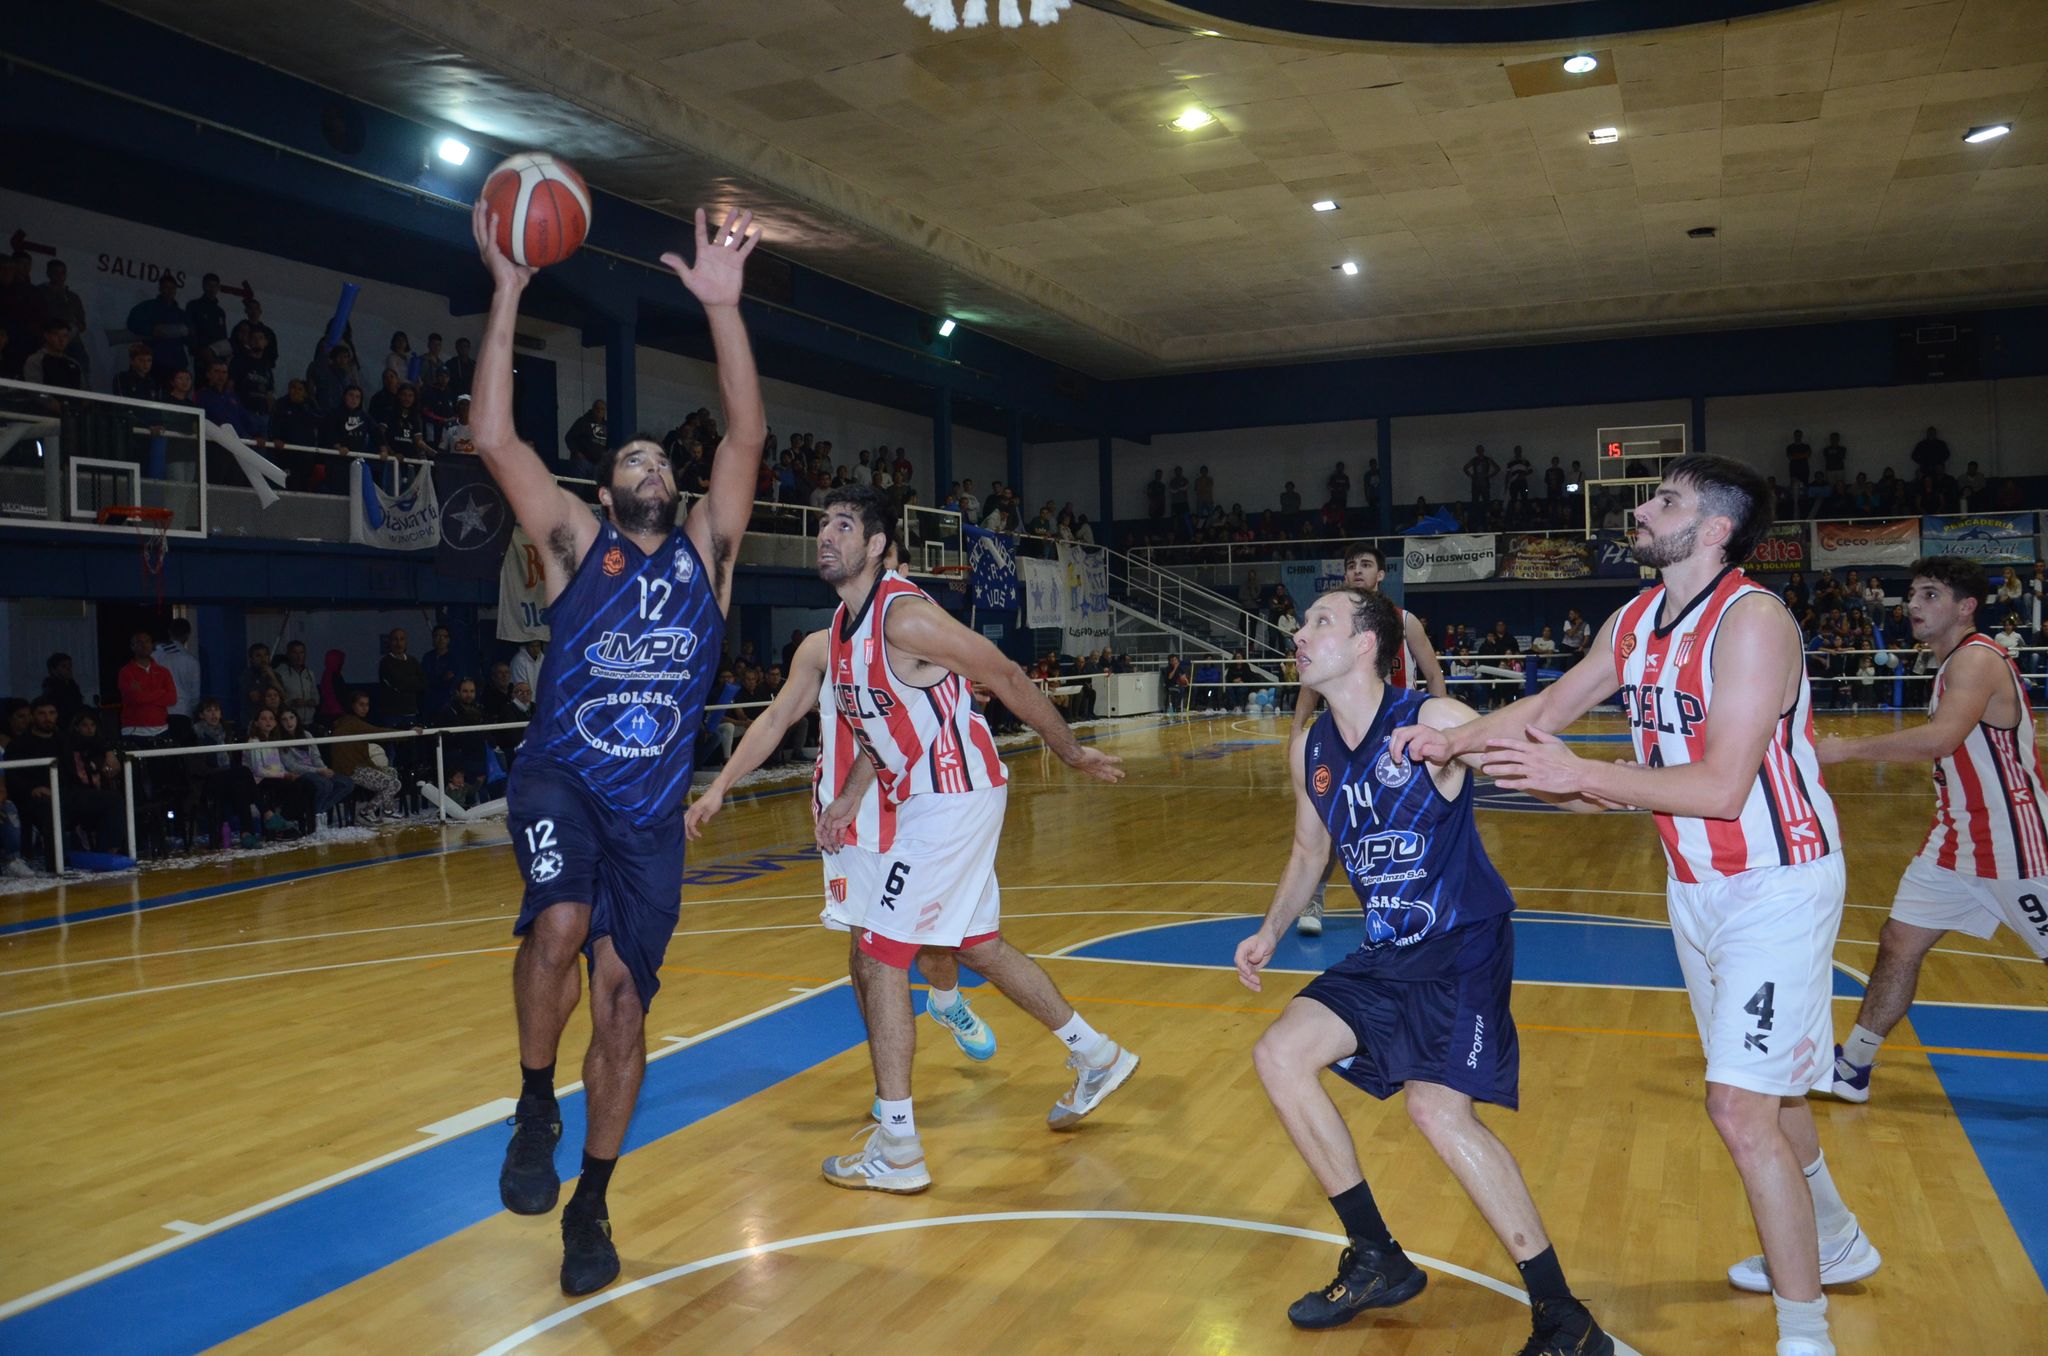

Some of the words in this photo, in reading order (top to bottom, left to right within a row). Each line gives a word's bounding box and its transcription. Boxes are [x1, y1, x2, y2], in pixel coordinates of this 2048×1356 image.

[1608, 443, 1621, 457] 15
[1426, 551, 1494, 563] Hauswagen
[1763, 562, 1801, 570] BOLIVAR
[637, 576, 672, 620] 12
[606, 691, 674, 707] BOLSAS
[1341, 782, 1379, 828] 14
[525, 820, 557, 853] 12
[1744, 981, 1775, 1031] 4
[1467, 1014, 1486, 1069] SPORTIA
